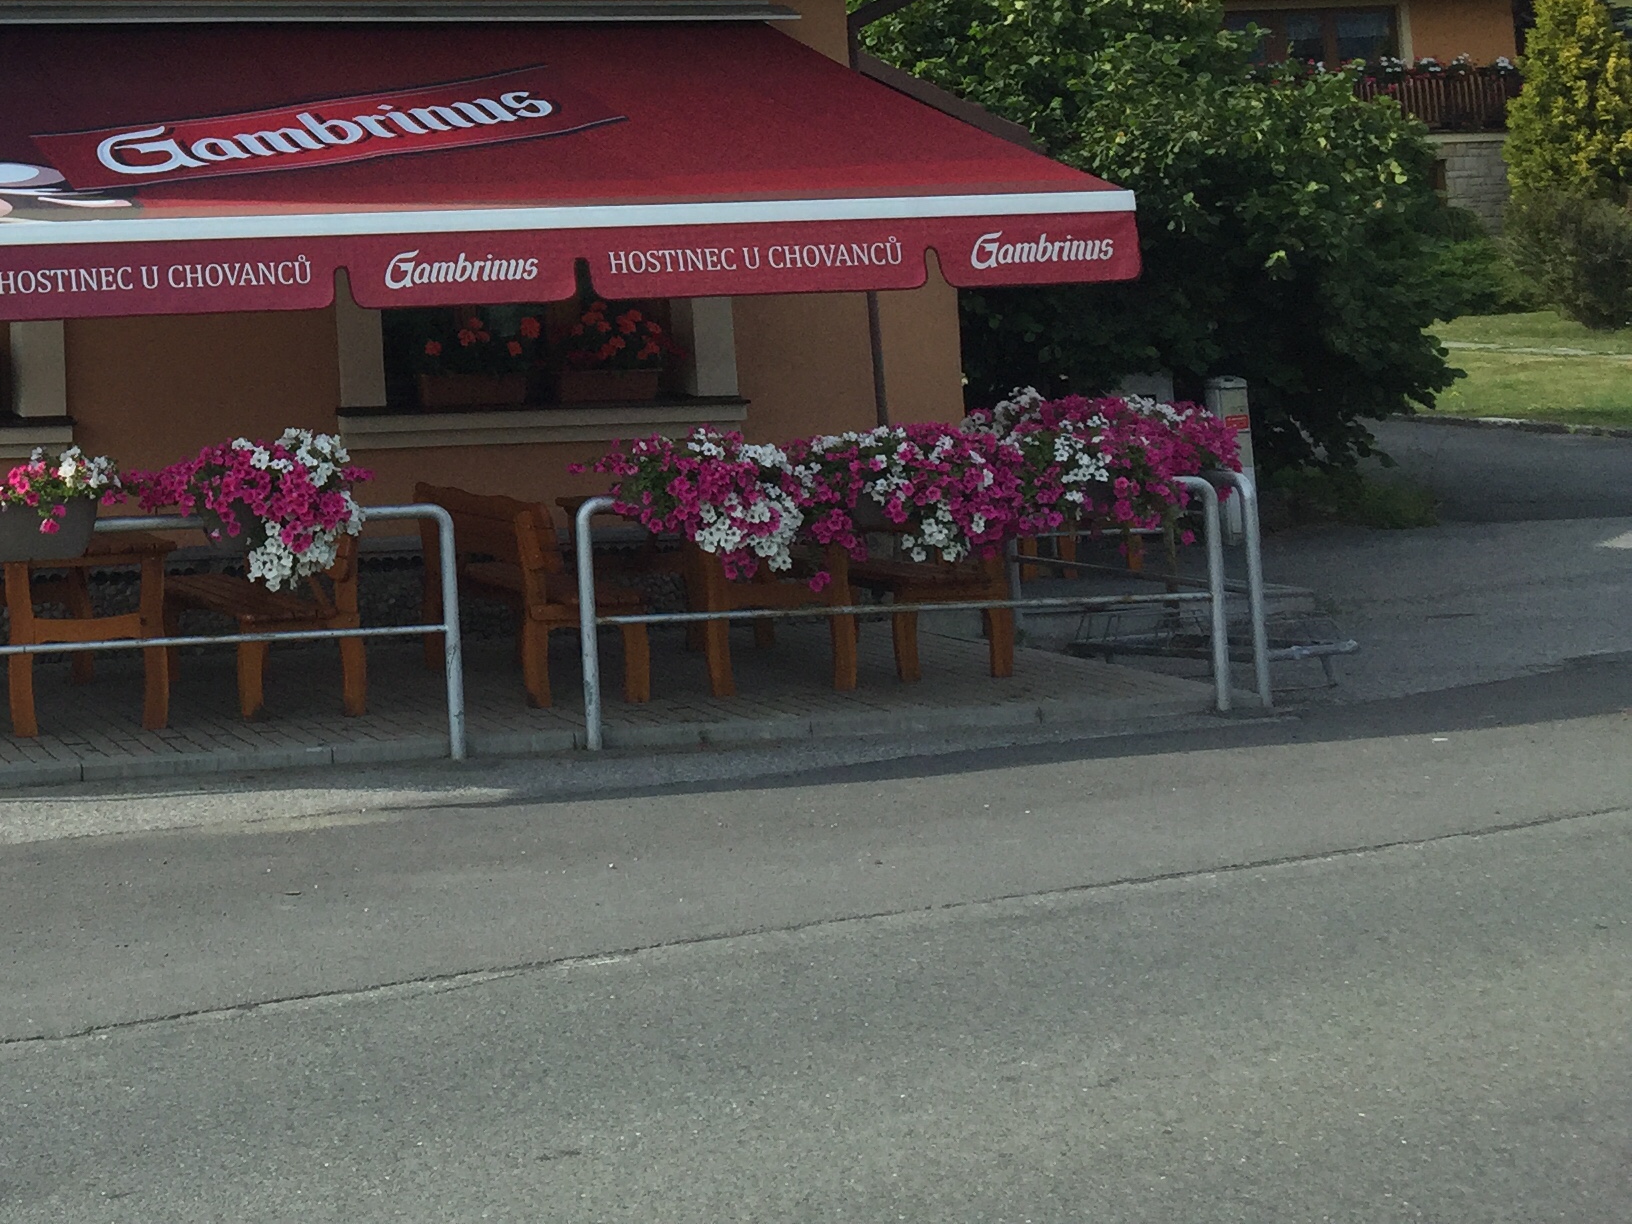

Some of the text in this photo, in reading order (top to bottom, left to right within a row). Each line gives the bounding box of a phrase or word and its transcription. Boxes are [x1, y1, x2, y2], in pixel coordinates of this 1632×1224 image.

[95, 90, 554, 175] Gambrinus
[384, 249, 539, 290] Gambrinus
[608, 235, 904, 275] HOSTINEC U CHOVANCŮ
[970, 230, 1114, 270] Gambrinus
[141, 264, 159, 289] U
[167, 254, 312, 289] CHOVANCŮ
